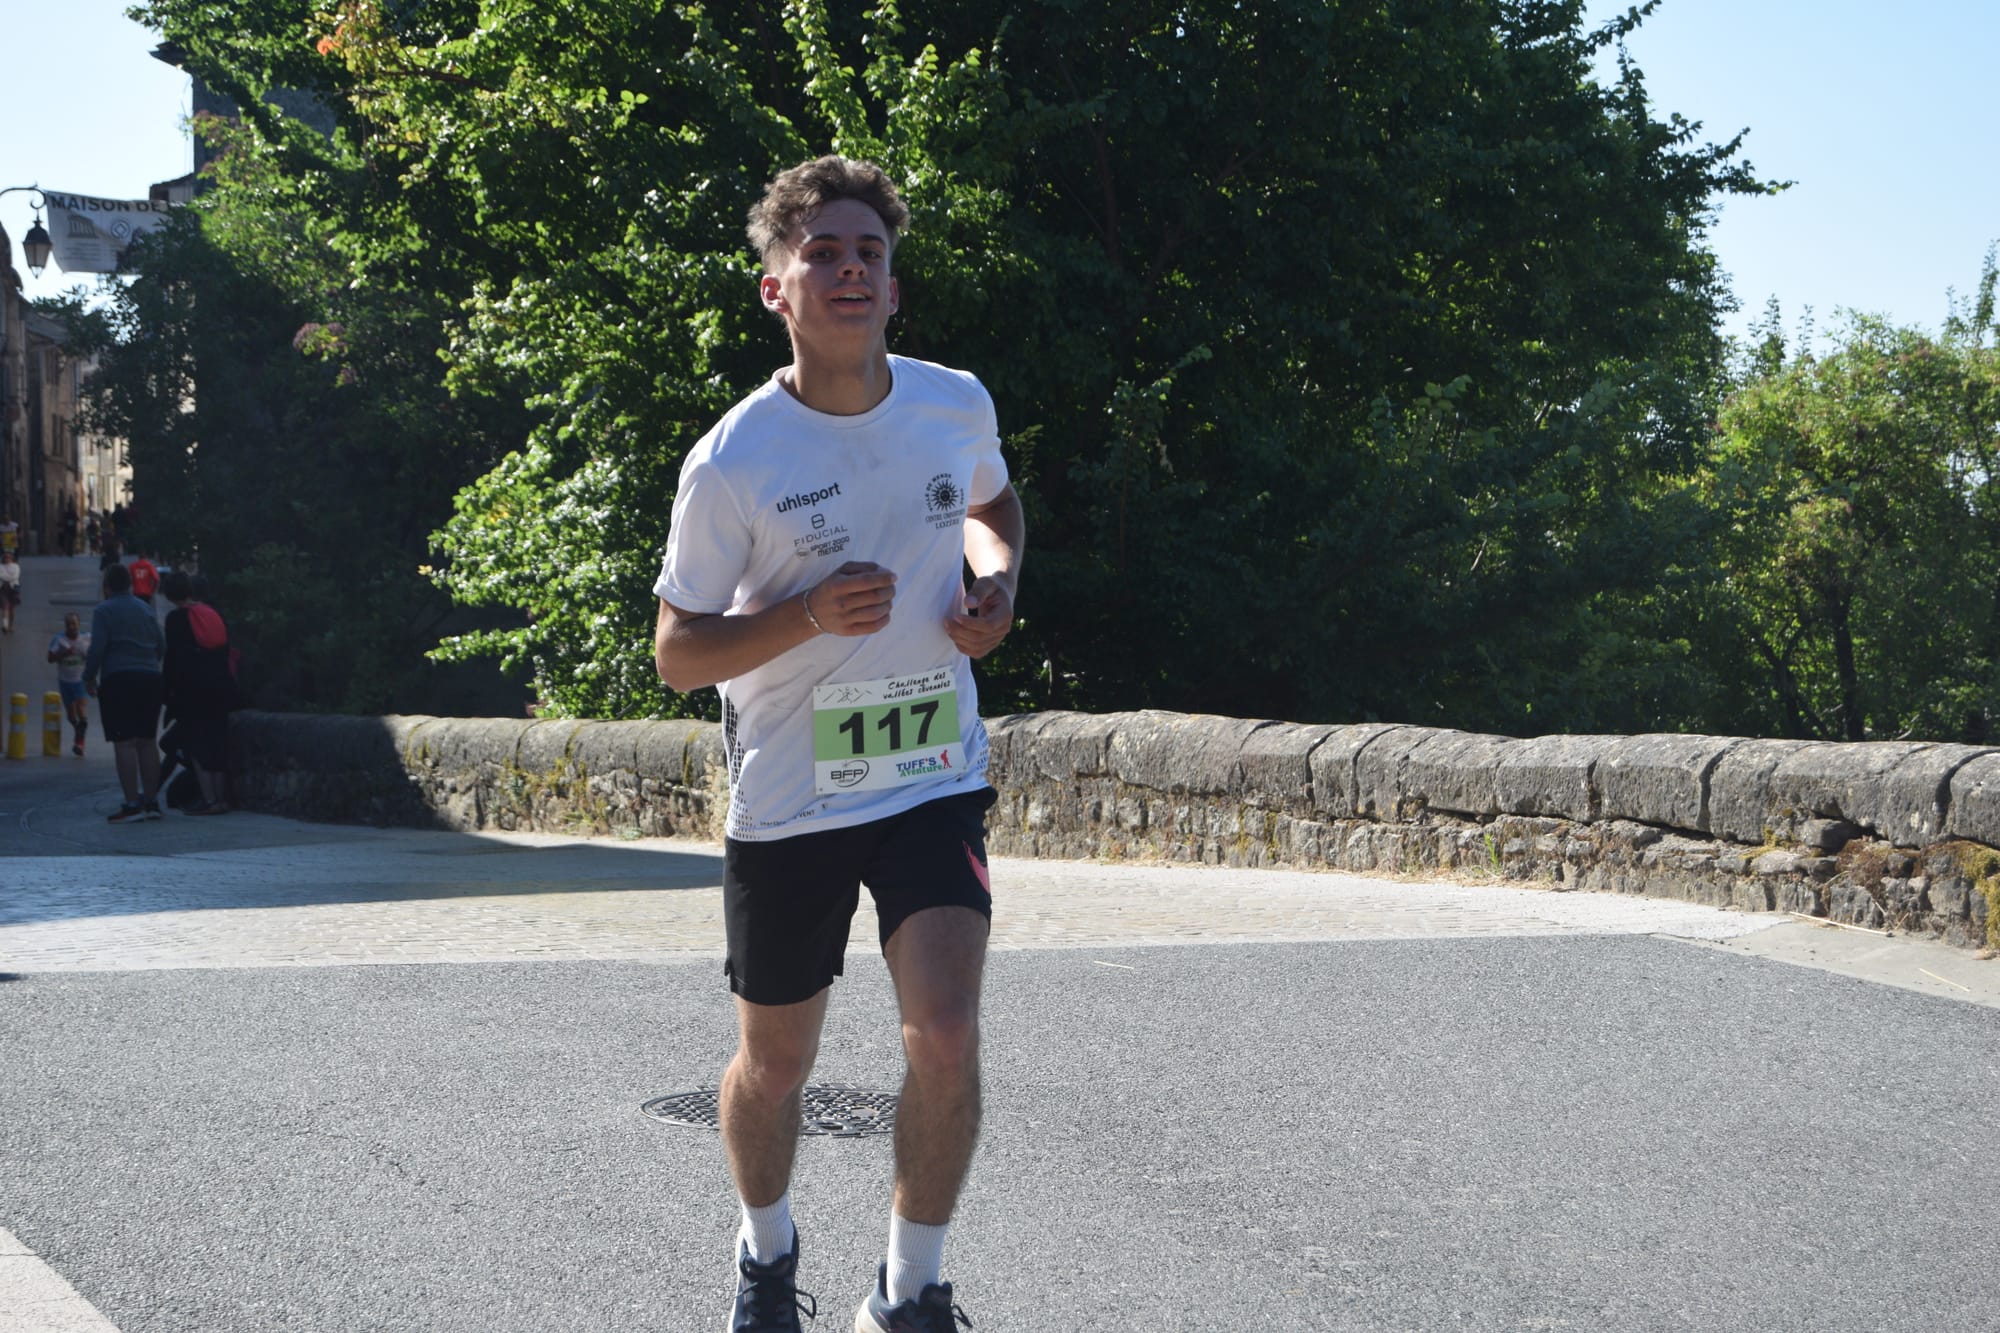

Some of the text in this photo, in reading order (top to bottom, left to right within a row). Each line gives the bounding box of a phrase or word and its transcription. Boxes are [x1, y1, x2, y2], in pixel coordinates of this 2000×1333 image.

[50, 195, 129, 212] MAISON
[776, 482, 841, 513] uhlsport
[794, 525, 848, 547] FIDUCIAL
[810, 536, 850, 552] SPORT 2000
[888, 672, 946, 690] Challenge des
[839, 700, 939, 755] 117
[896, 757, 937, 773] TUFF'S
[900, 764, 943, 777] Aventure
[831, 769, 864, 780] BFP
